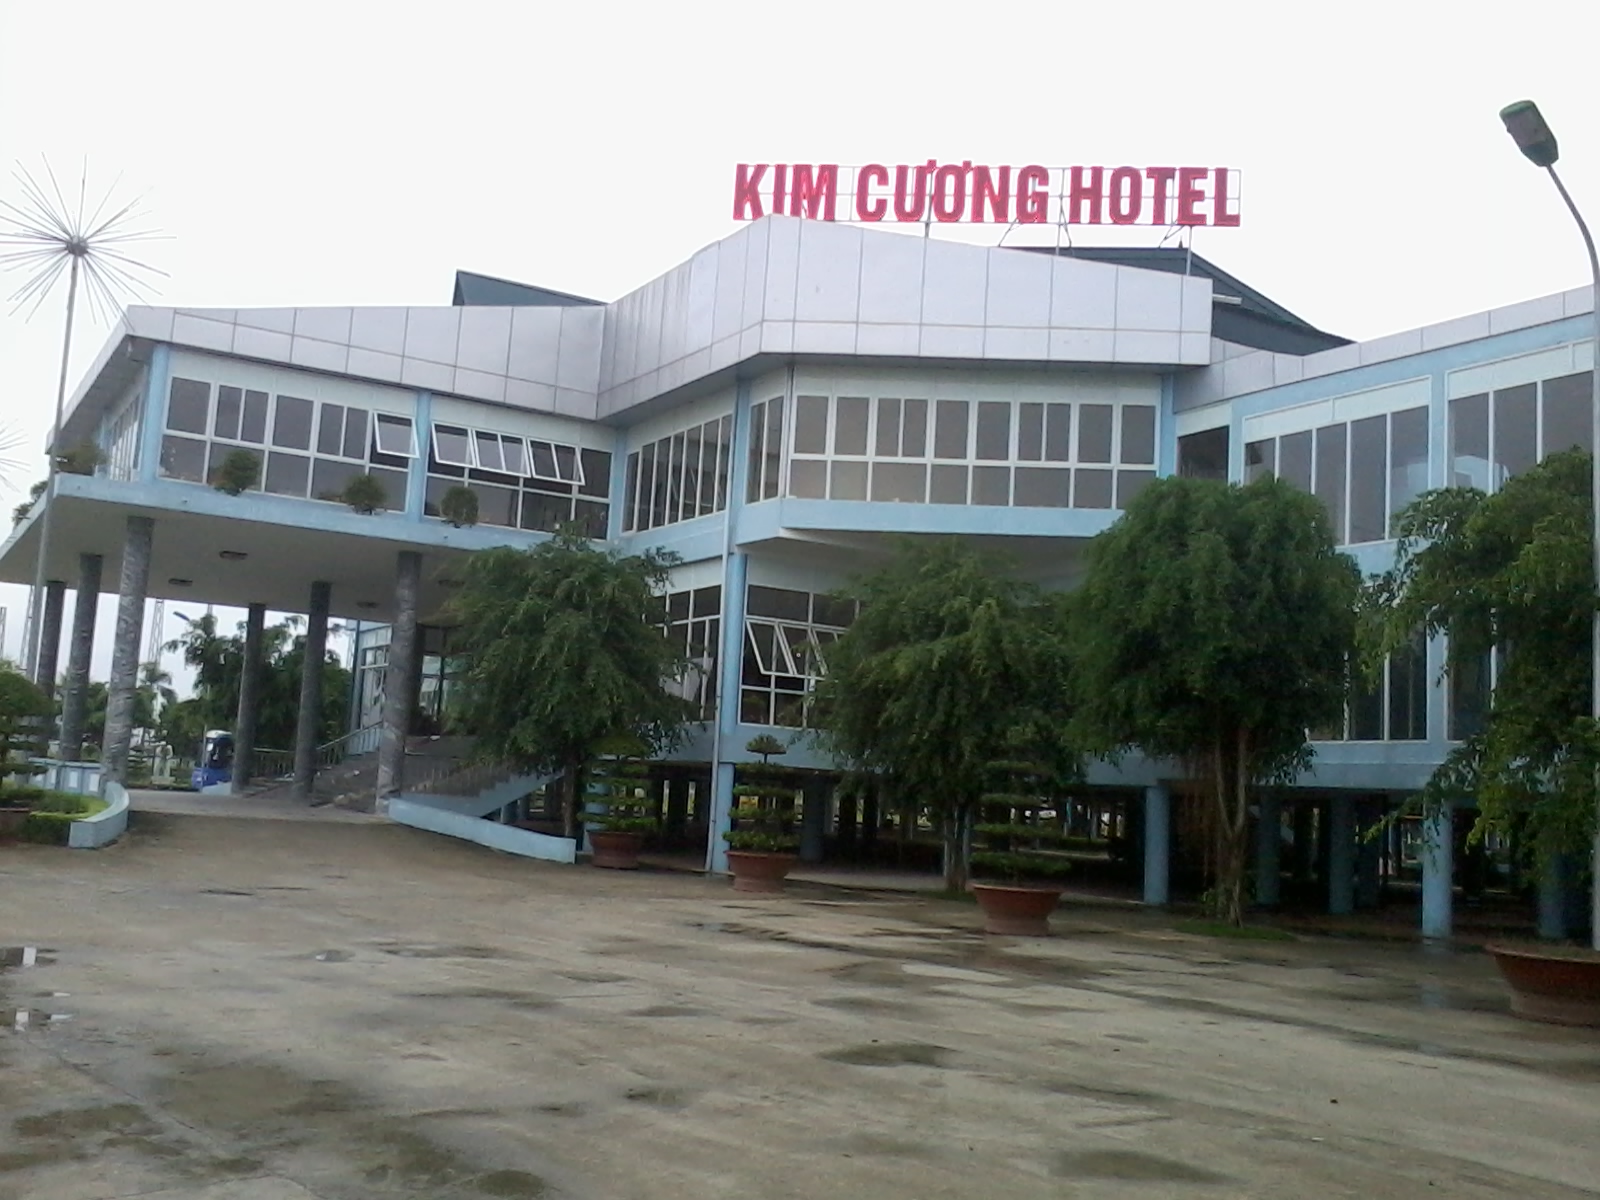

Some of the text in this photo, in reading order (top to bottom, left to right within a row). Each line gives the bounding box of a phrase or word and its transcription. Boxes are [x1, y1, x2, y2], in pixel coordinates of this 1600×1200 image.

[733, 159, 1240, 226] KIM CƯƠNG HOTEL
